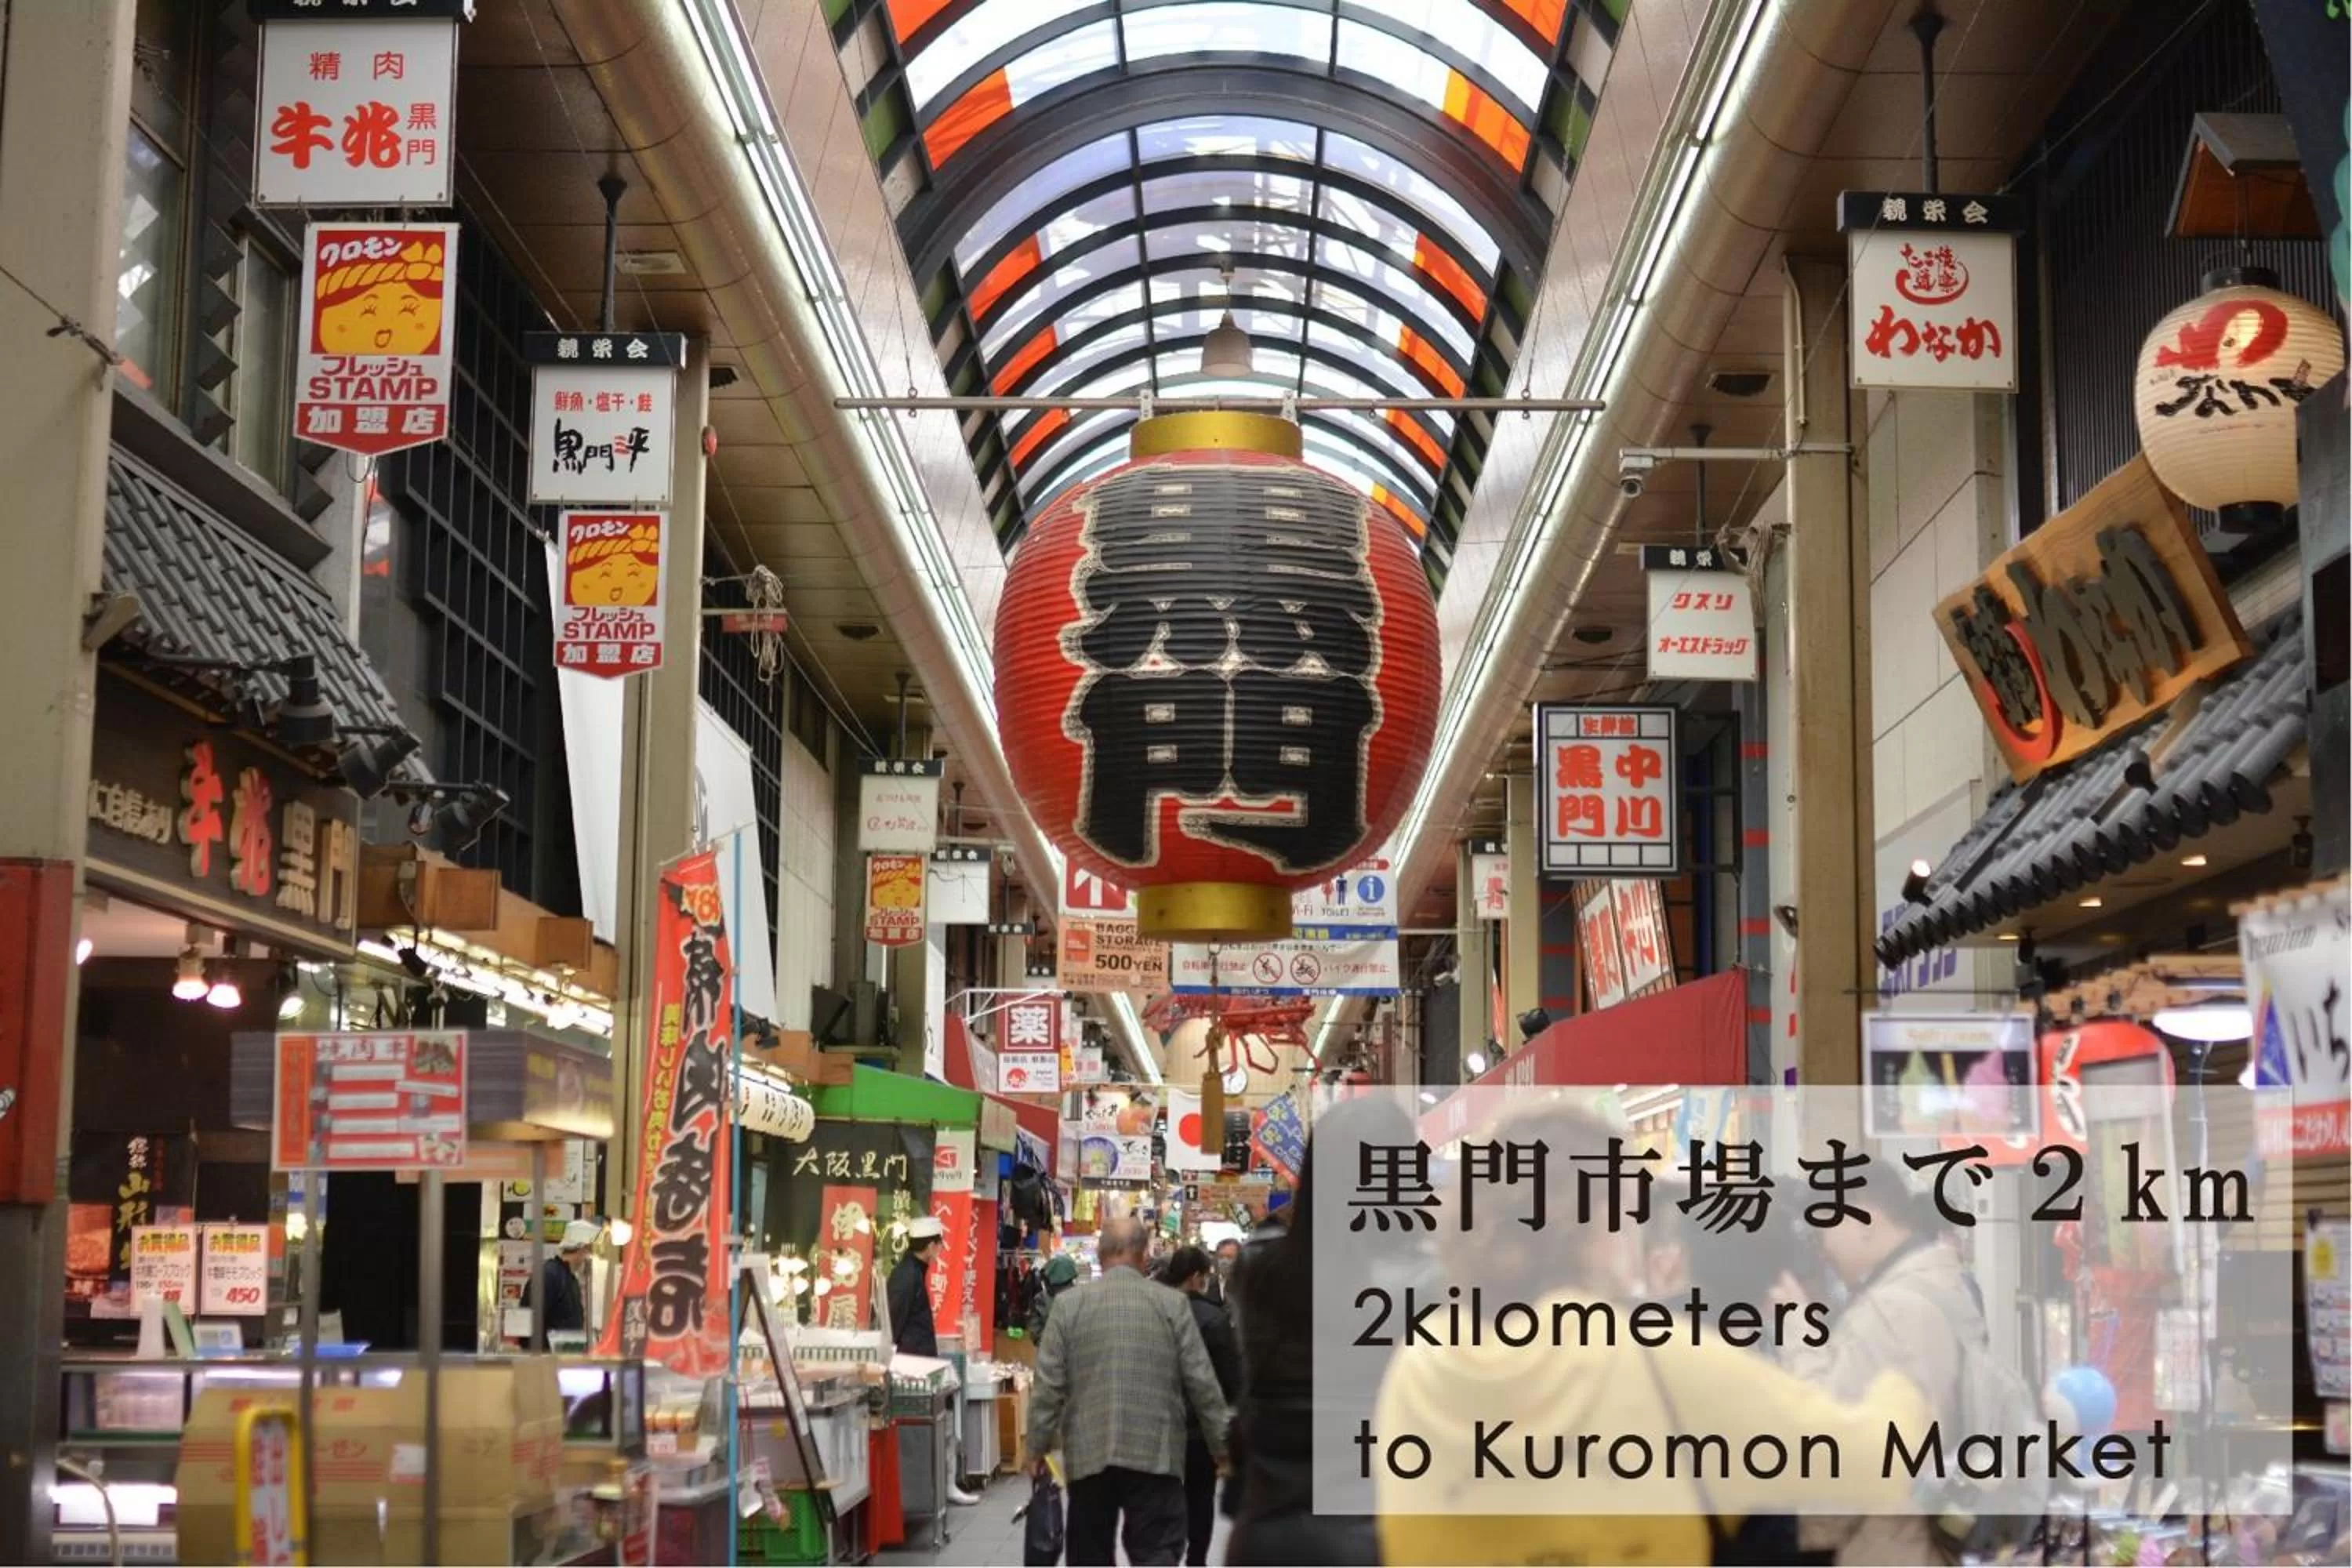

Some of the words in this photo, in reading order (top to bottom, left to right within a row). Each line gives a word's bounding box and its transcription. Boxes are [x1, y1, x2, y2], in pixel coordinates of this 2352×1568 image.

[309, 50, 405, 82] 精肉
[405, 102, 437, 166] 黒門
[319, 235, 402, 268] クロモン
[1864, 303, 2002, 364] わなか
[321, 356, 425, 377] フレッシュ
[307, 376, 439, 401] STAMP
[307, 405, 437, 434] 加盟店
[570, 519, 630, 544] クロモン
[572, 606, 646, 622] フレッシュ
[1671, 591, 1734, 611] クスリ
[563, 622, 656, 641] STAMP
[562, 642, 656, 664] 加盟店
[1058, 463, 1384, 872] 黒門
[1010, 1006, 1048, 1044] 薬
[793, 1145, 908, 1181] 大阪黒門
[225, 1287, 261, 1305] 450
